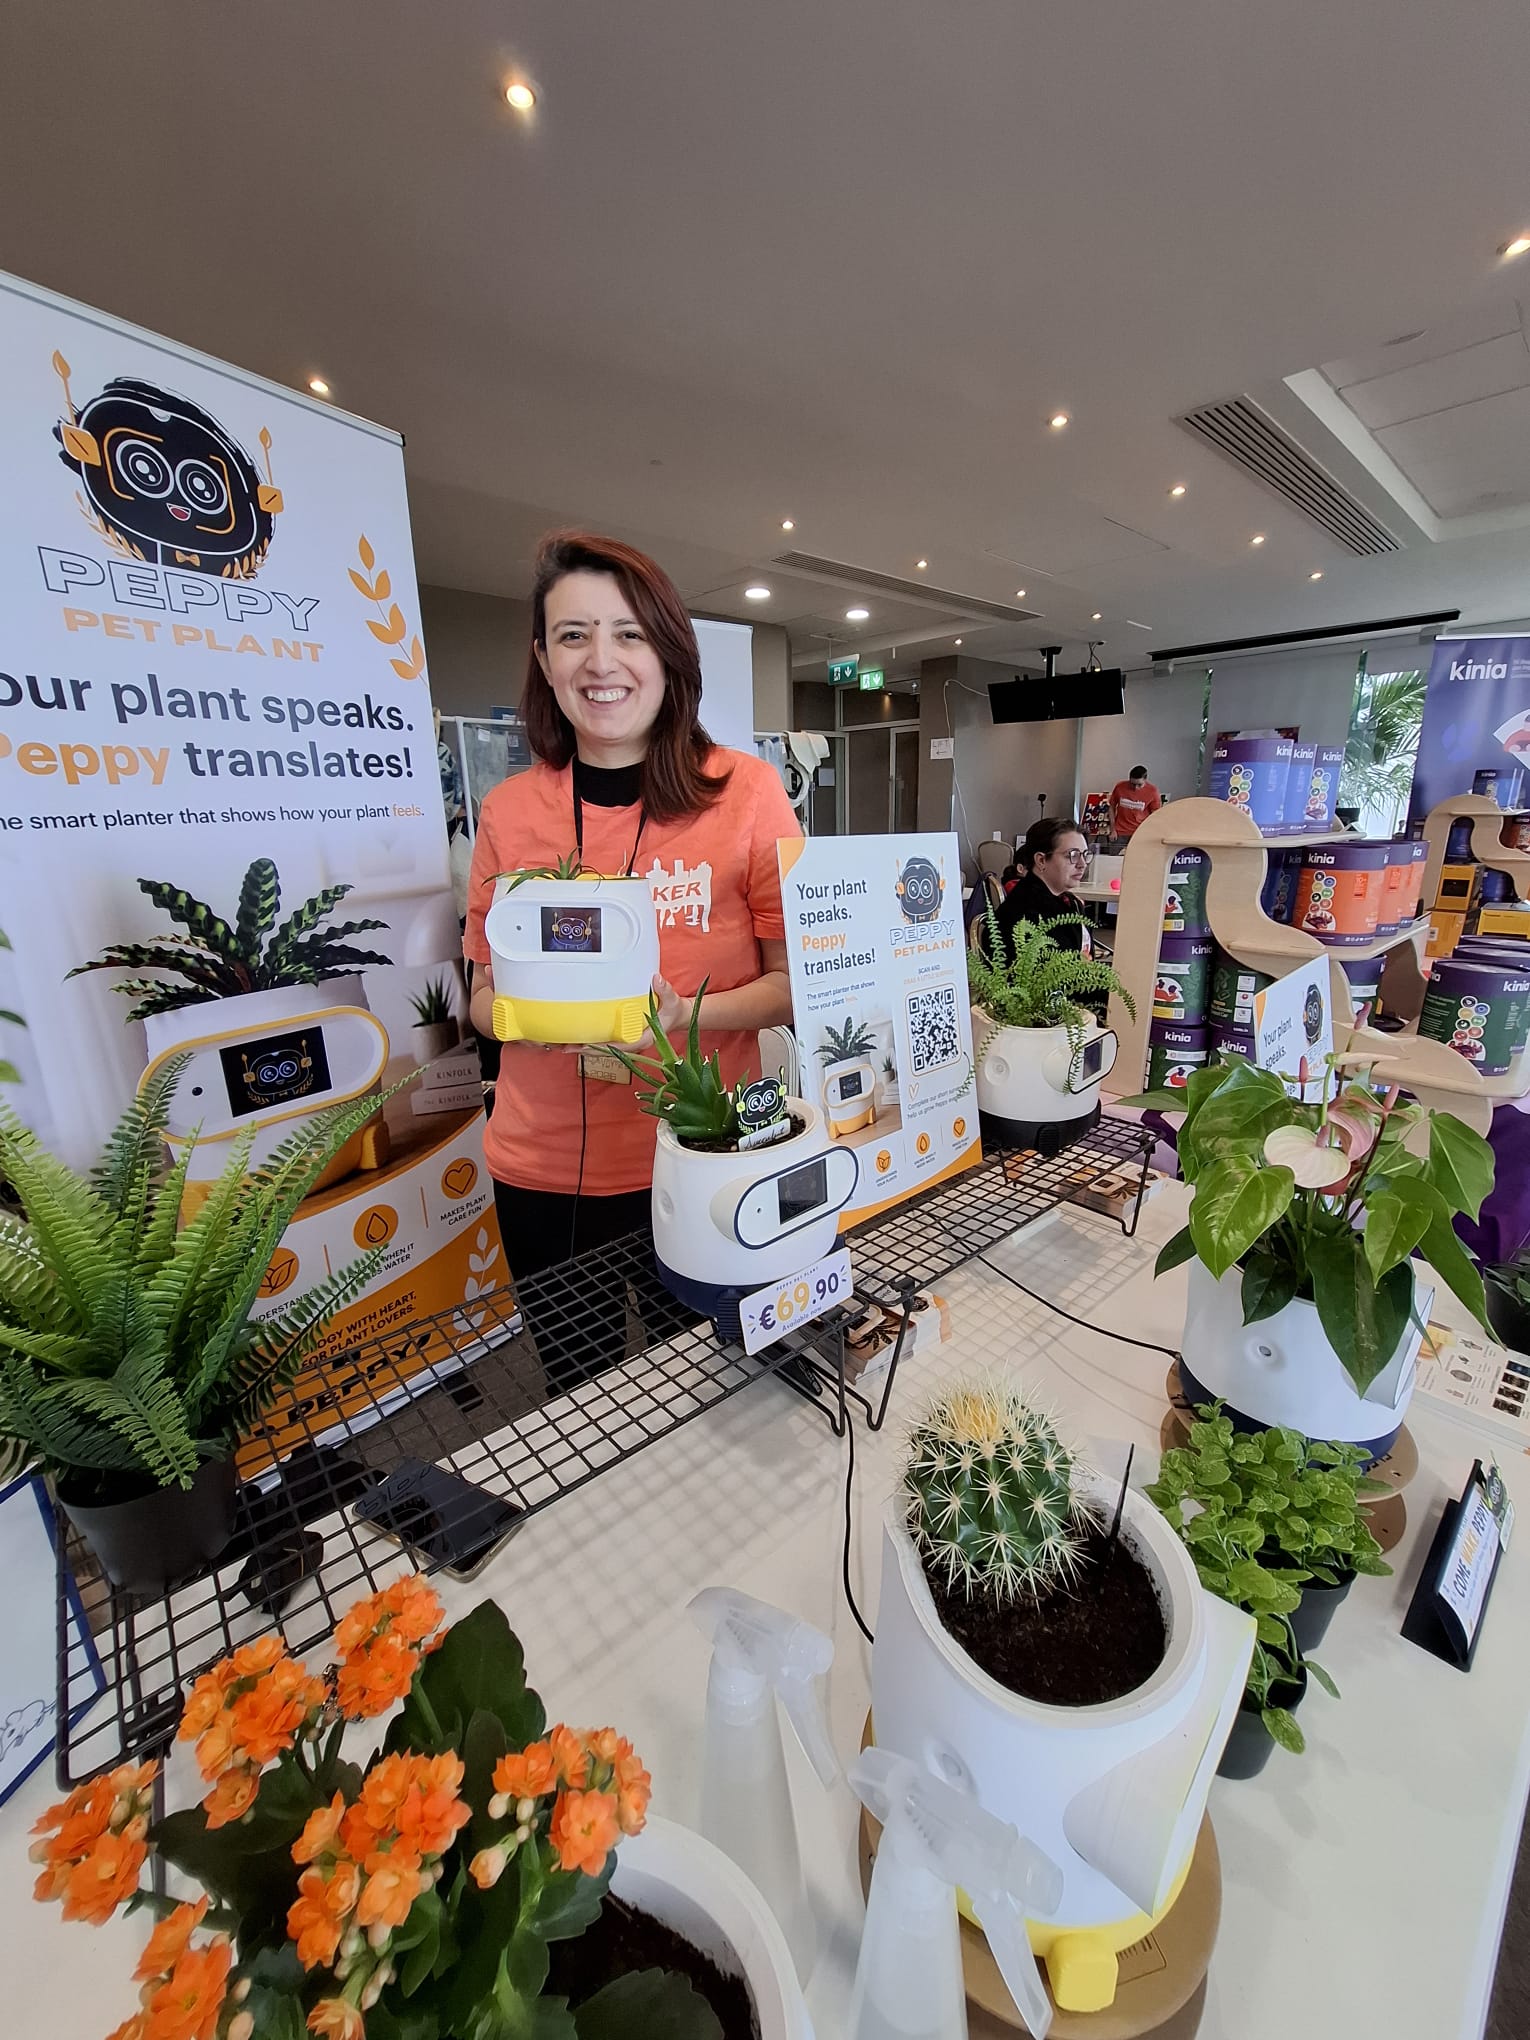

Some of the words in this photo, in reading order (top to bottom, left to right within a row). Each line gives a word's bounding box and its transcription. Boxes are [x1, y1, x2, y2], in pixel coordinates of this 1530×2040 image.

[37, 545, 320, 632] PEPPY
[63, 607, 162, 643] PET
[172, 624, 324, 663] PLANT
[1450, 658, 1508, 681] kinia
[0, 672, 92, 711] our
[111, 673, 251, 724] plant
[262, 694, 414, 733] speaks.
[183, 741, 413, 779] translates!
[30, 812, 98, 830] smart
[103, 809, 174, 831] planter
[179, 808, 217, 825] that
[221, 806, 276, 823] shows
[280, 806, 315, 821] how
[318, 808, 352, 822] your
[356, 805, 390, 821] plant
[392, 804, 425, 818] feels.
[1174, 854, 1202, 865] kinia
[1308, 852, 1335, 865] kinia
[653, 881, 702, 902] KER
[796, 882, 829, 900] Your
[833, 879, 867, 899] plant
[799, 904, 852, 928] speaks.
[802, 932, 846, 953] Peppy
[890, 919, 955, 946] PEPPY
[894, 946, 915, 958] PET
[917, 938, 955, 953] PLANT
[804, 948, 876, 976] translates!
[1165, 1031, 1192, 1043] kinia
[1221, 1039, 1247, 1054] kinia
[436, 1068, 473, 1079] KINFOLK
[440, 1205, 465, 1221] MAKES
[466, 1194, 487, 1209] PLANT
[448, 1212, 467, 1226] CARE
[468, 1205, 482, 1216] FUN
[407, 1243, 415, 1252] IT
[384, 1253, 411, 1271] WATER
[759, 1272, 839, 1330] €69.90
[346, 1311, 377, 1334] WITH
[782, 1313, 809, 1332] Available
[330, 1328, 369, 1355] PLANT
[1453, 1558, 1471, 1599] COME
